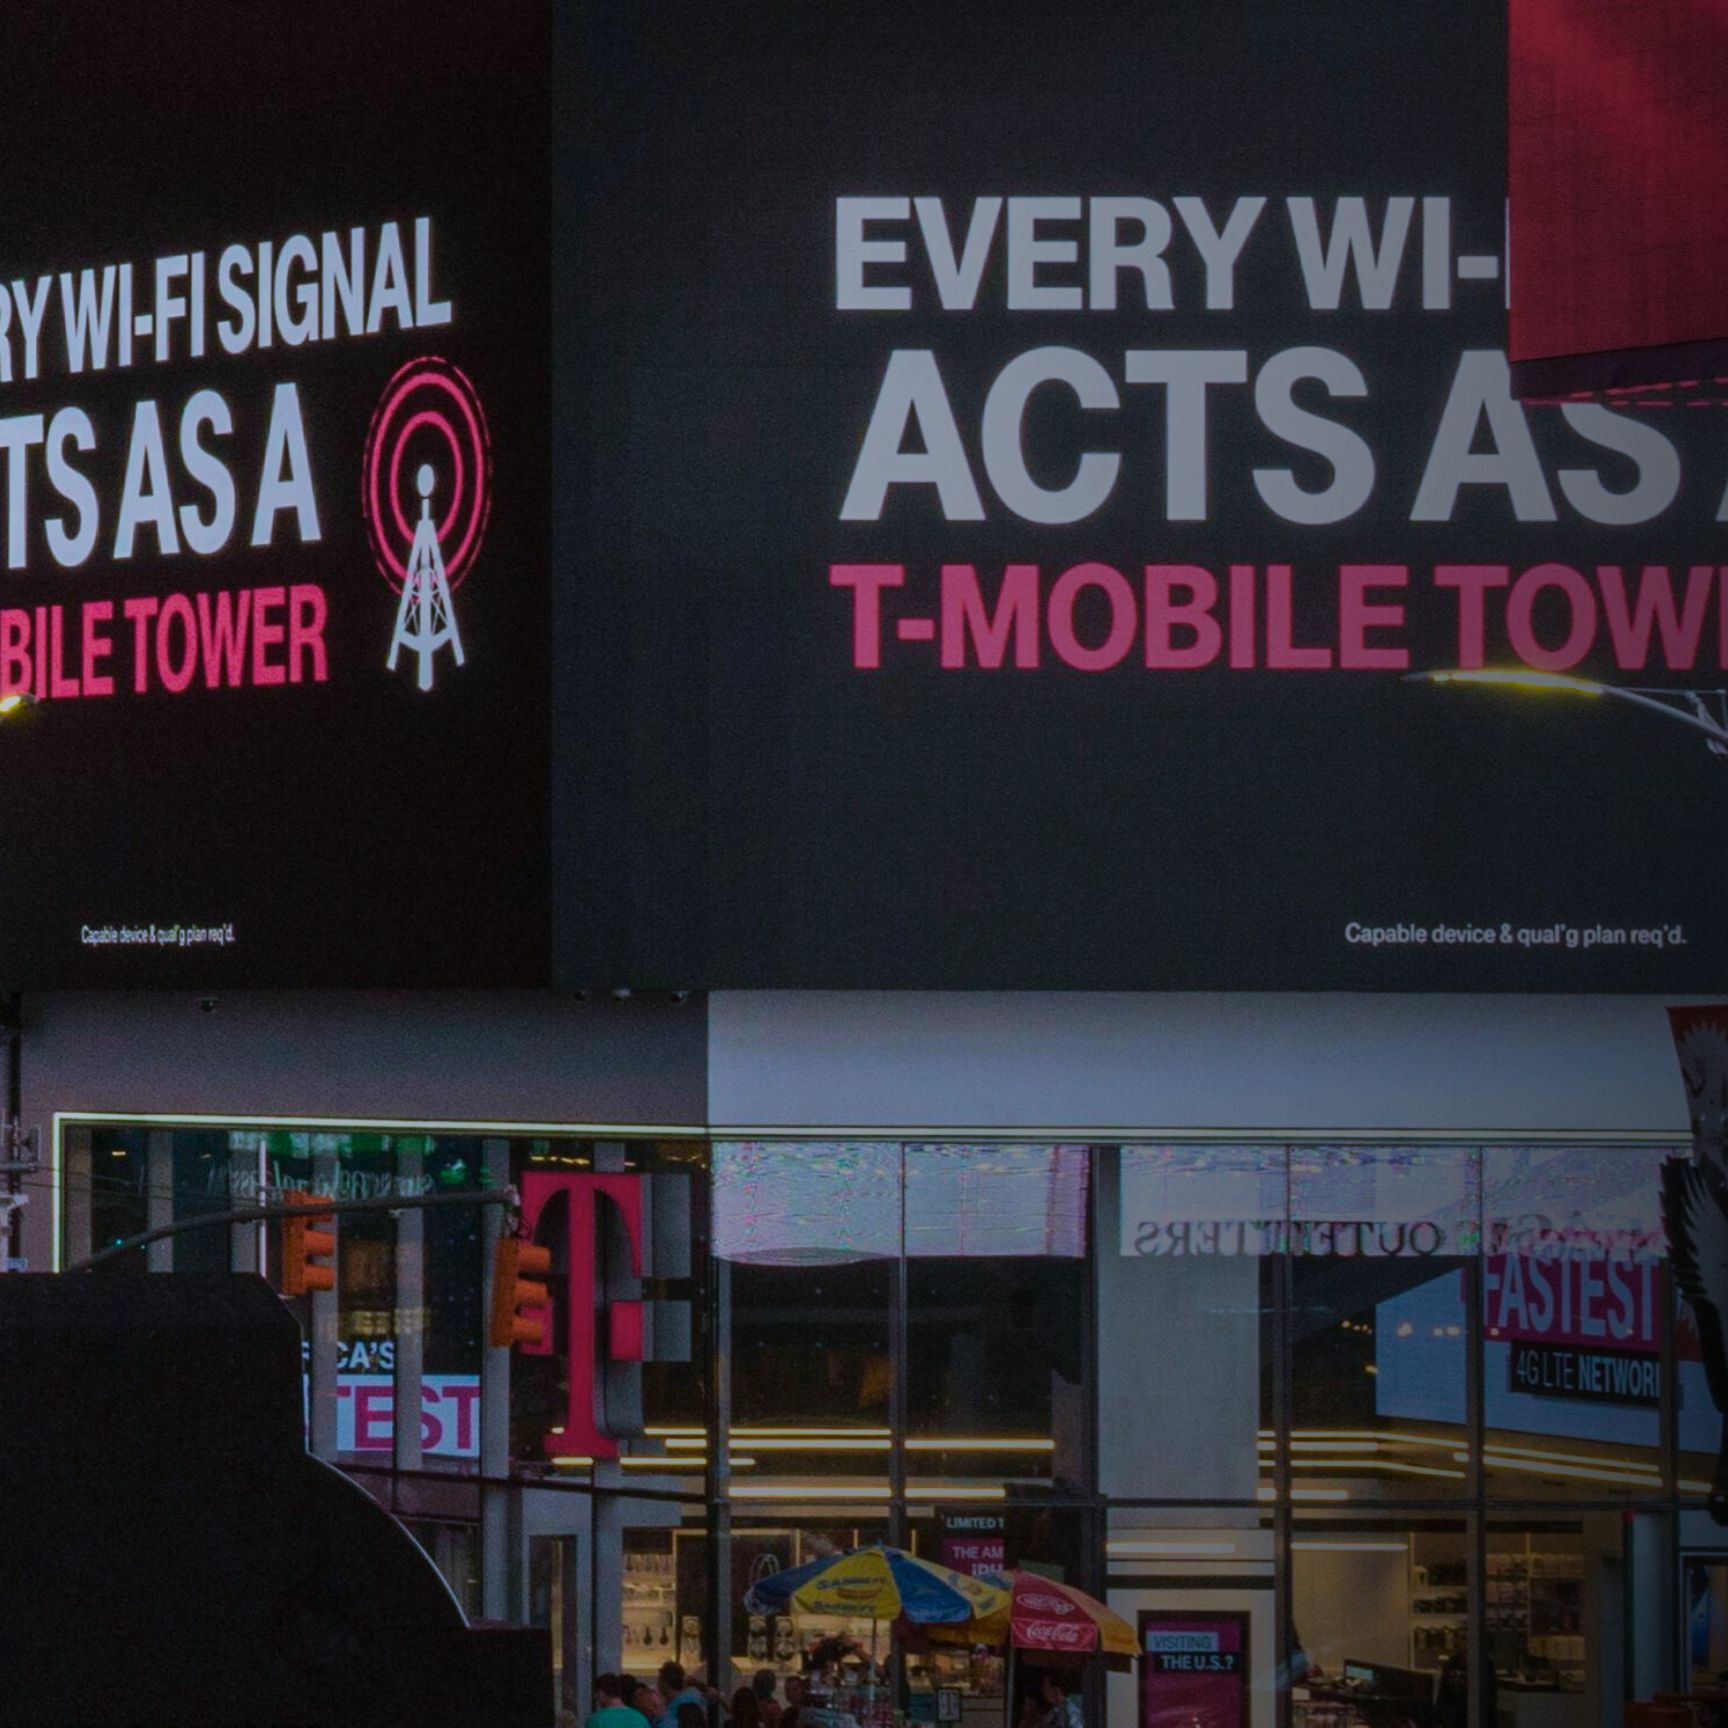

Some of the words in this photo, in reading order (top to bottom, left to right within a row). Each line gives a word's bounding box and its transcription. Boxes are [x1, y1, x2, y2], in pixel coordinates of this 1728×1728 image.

[834, 196, 1267, 310] EVERY
[58, 248, 206, 376] WI-FI
[216, 215, 455, 355] SIGNAL
[111, 387, 237, 561] AS
[250, 381, 323, 547] A
[839, 345, 1378, 524] ACTS
[121, 582, 331, 695] TOWER
[829, 562, 1411, 672] T-MOBILE
[1344, 922, 1428, 947] Capable
[1432, 922, 1497, 944] device
[1499, 922, 1514, 944] &
[1583, 923, 1626, 948] plan
[1631, 922, 1688, 949] req'd.
[1516, 1350, 1540, 1386] 4G
[1542, 1352, 1575, 1389] LTE
[945, 1516, 995, 1530] LIMITED
[952, 1545, 980, 1560] THE
[1153, 1635, 1212, 1651] VISITING
[1161, 1655, 1193, 1671] THE
[1194, 1655, 1235, 1671] U.S.?
